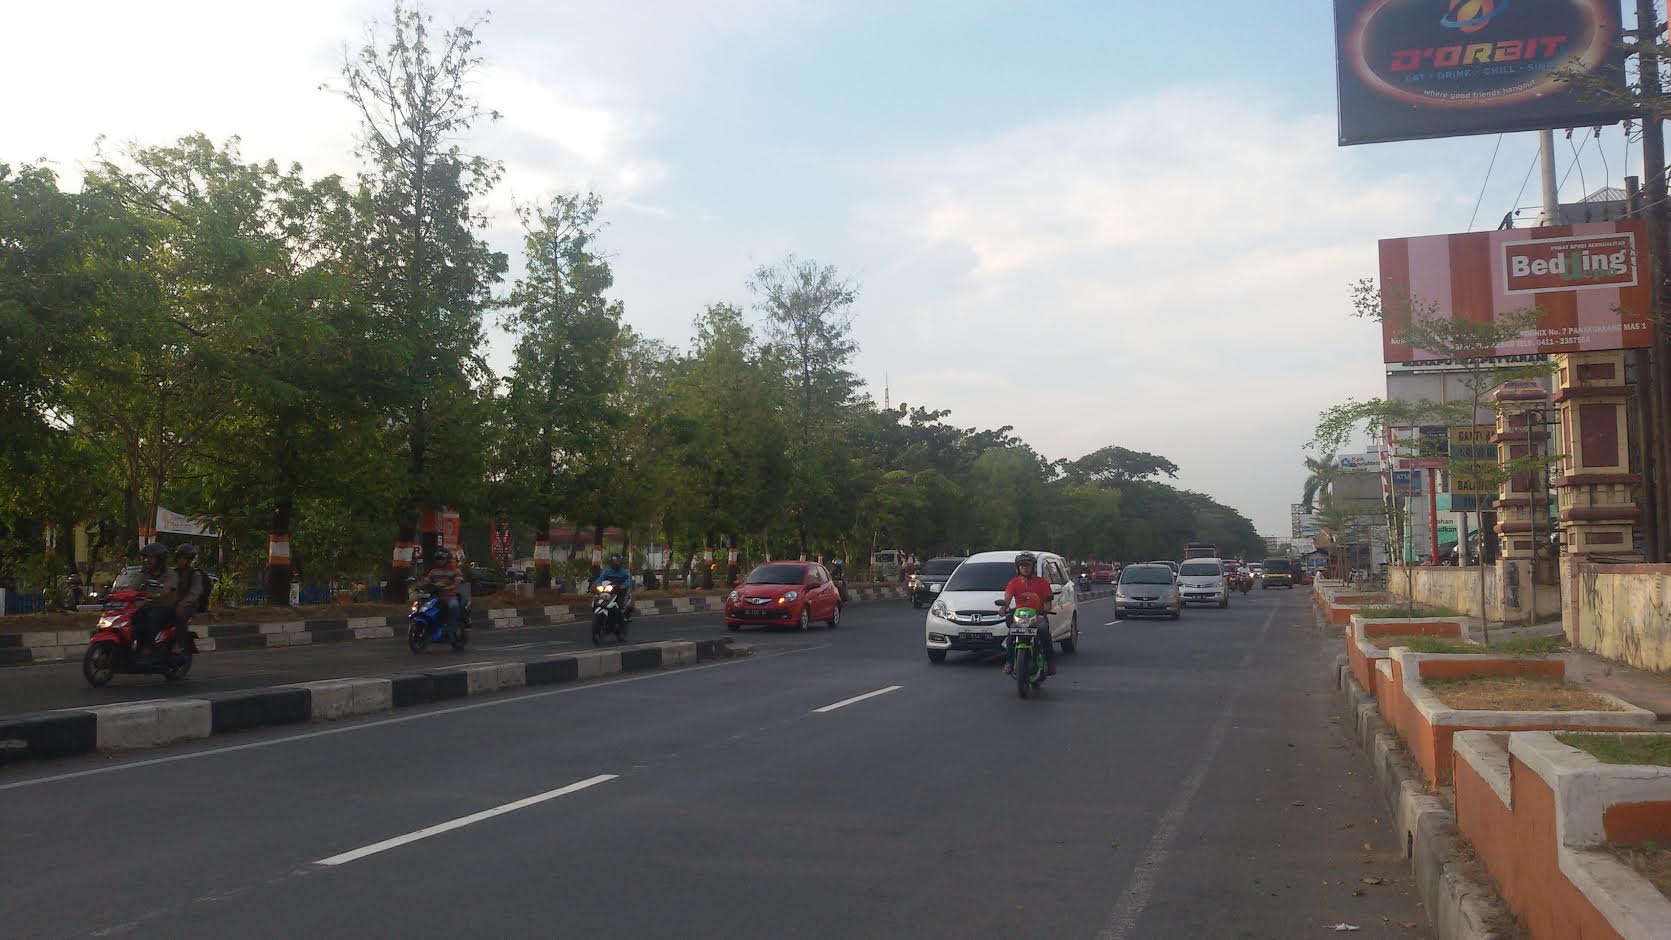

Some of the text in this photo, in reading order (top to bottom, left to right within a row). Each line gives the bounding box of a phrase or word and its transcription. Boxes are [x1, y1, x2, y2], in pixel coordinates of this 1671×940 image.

[1391, 35, 1567, 72] D'ORBIT
[1439, 69, 1471, 80] DRINK
[1484, 65, 1516, 75] CHILL
[1423, 89, 1448, 98] where
[1473, 90, 1501, 98] friends
[1502, 80, 1536, 94] hangout
[1623, 323, 1640, 331] MAS
[1641, 322, 1647, 330] 1
[1536, 337, 1555, 346] 0411
